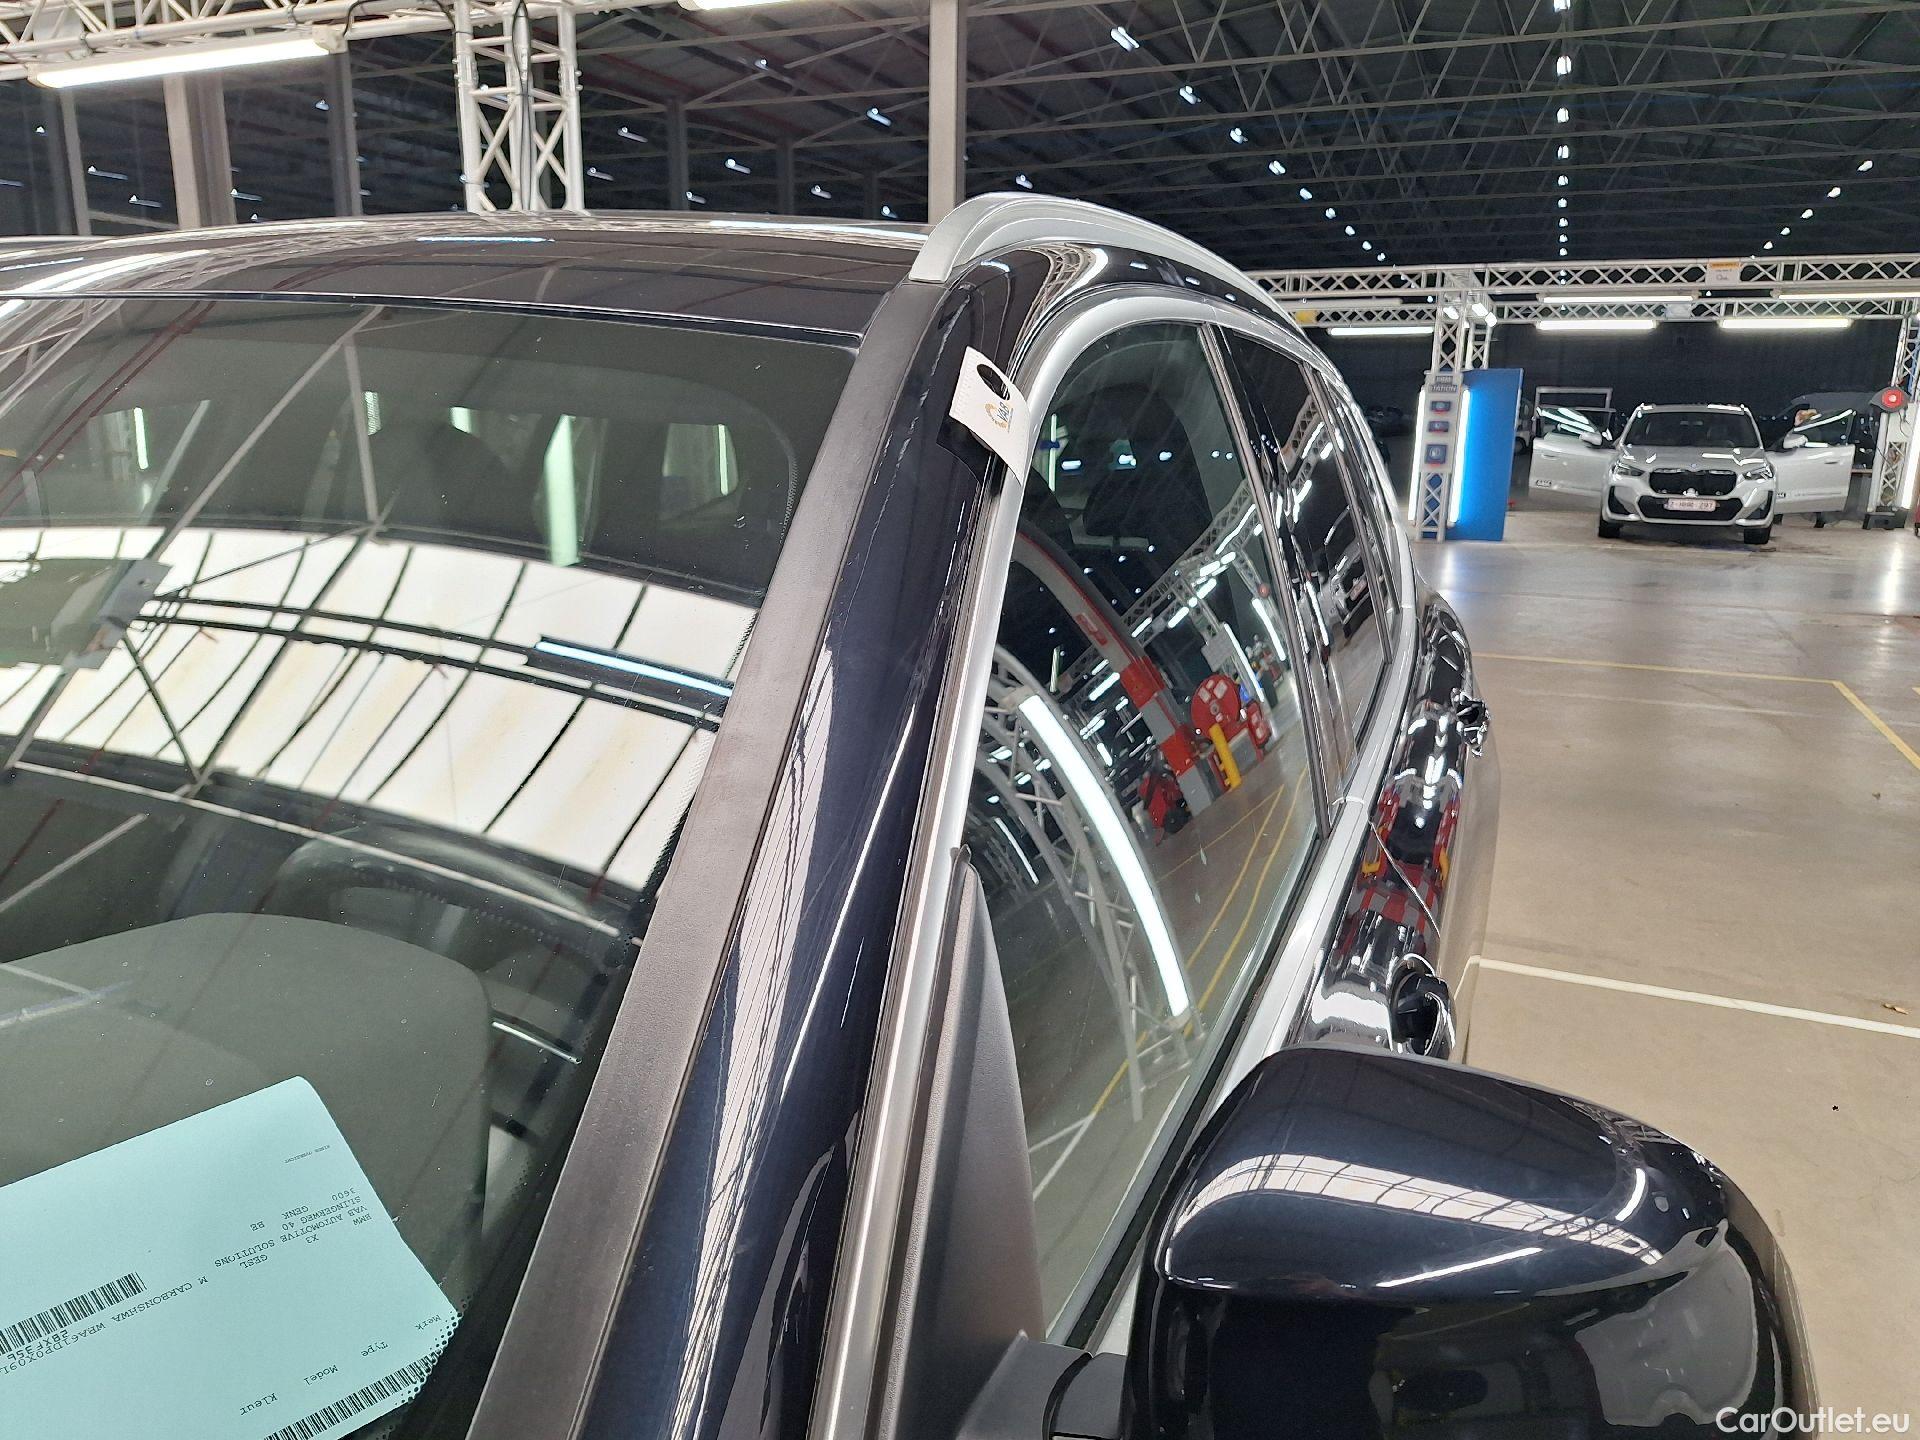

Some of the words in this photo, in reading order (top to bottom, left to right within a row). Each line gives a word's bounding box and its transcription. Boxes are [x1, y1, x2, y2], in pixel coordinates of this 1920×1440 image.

[331, 1187, 356, 1201] 3600
[281, 1205, 309, 1220] GENK
[300, 1195, 361, 1224] SLINGERWEG
[347, 1205, 368, 1217] VAB
[250, 1221, 265, 1231] BE
[281, 1221, 295, 1231] 40
[352, 1213, 372, 1226] BMW
[279, 1214, 344, 1242] AUTOMOTIVE
[305, 1234, 319, 1244] X3
[214, 1239, 275, 1267] SOLUTIONS
[239, 1254, 268, 1268] GESL
[197, 1276, 209, 1285] M
[414, 1314, 441, 1331] Merk
[361, 1341, 389, 1358] Type
[303, 1364, 339, 1386] Model
[239, 1393, 278, 1416] Kleur
